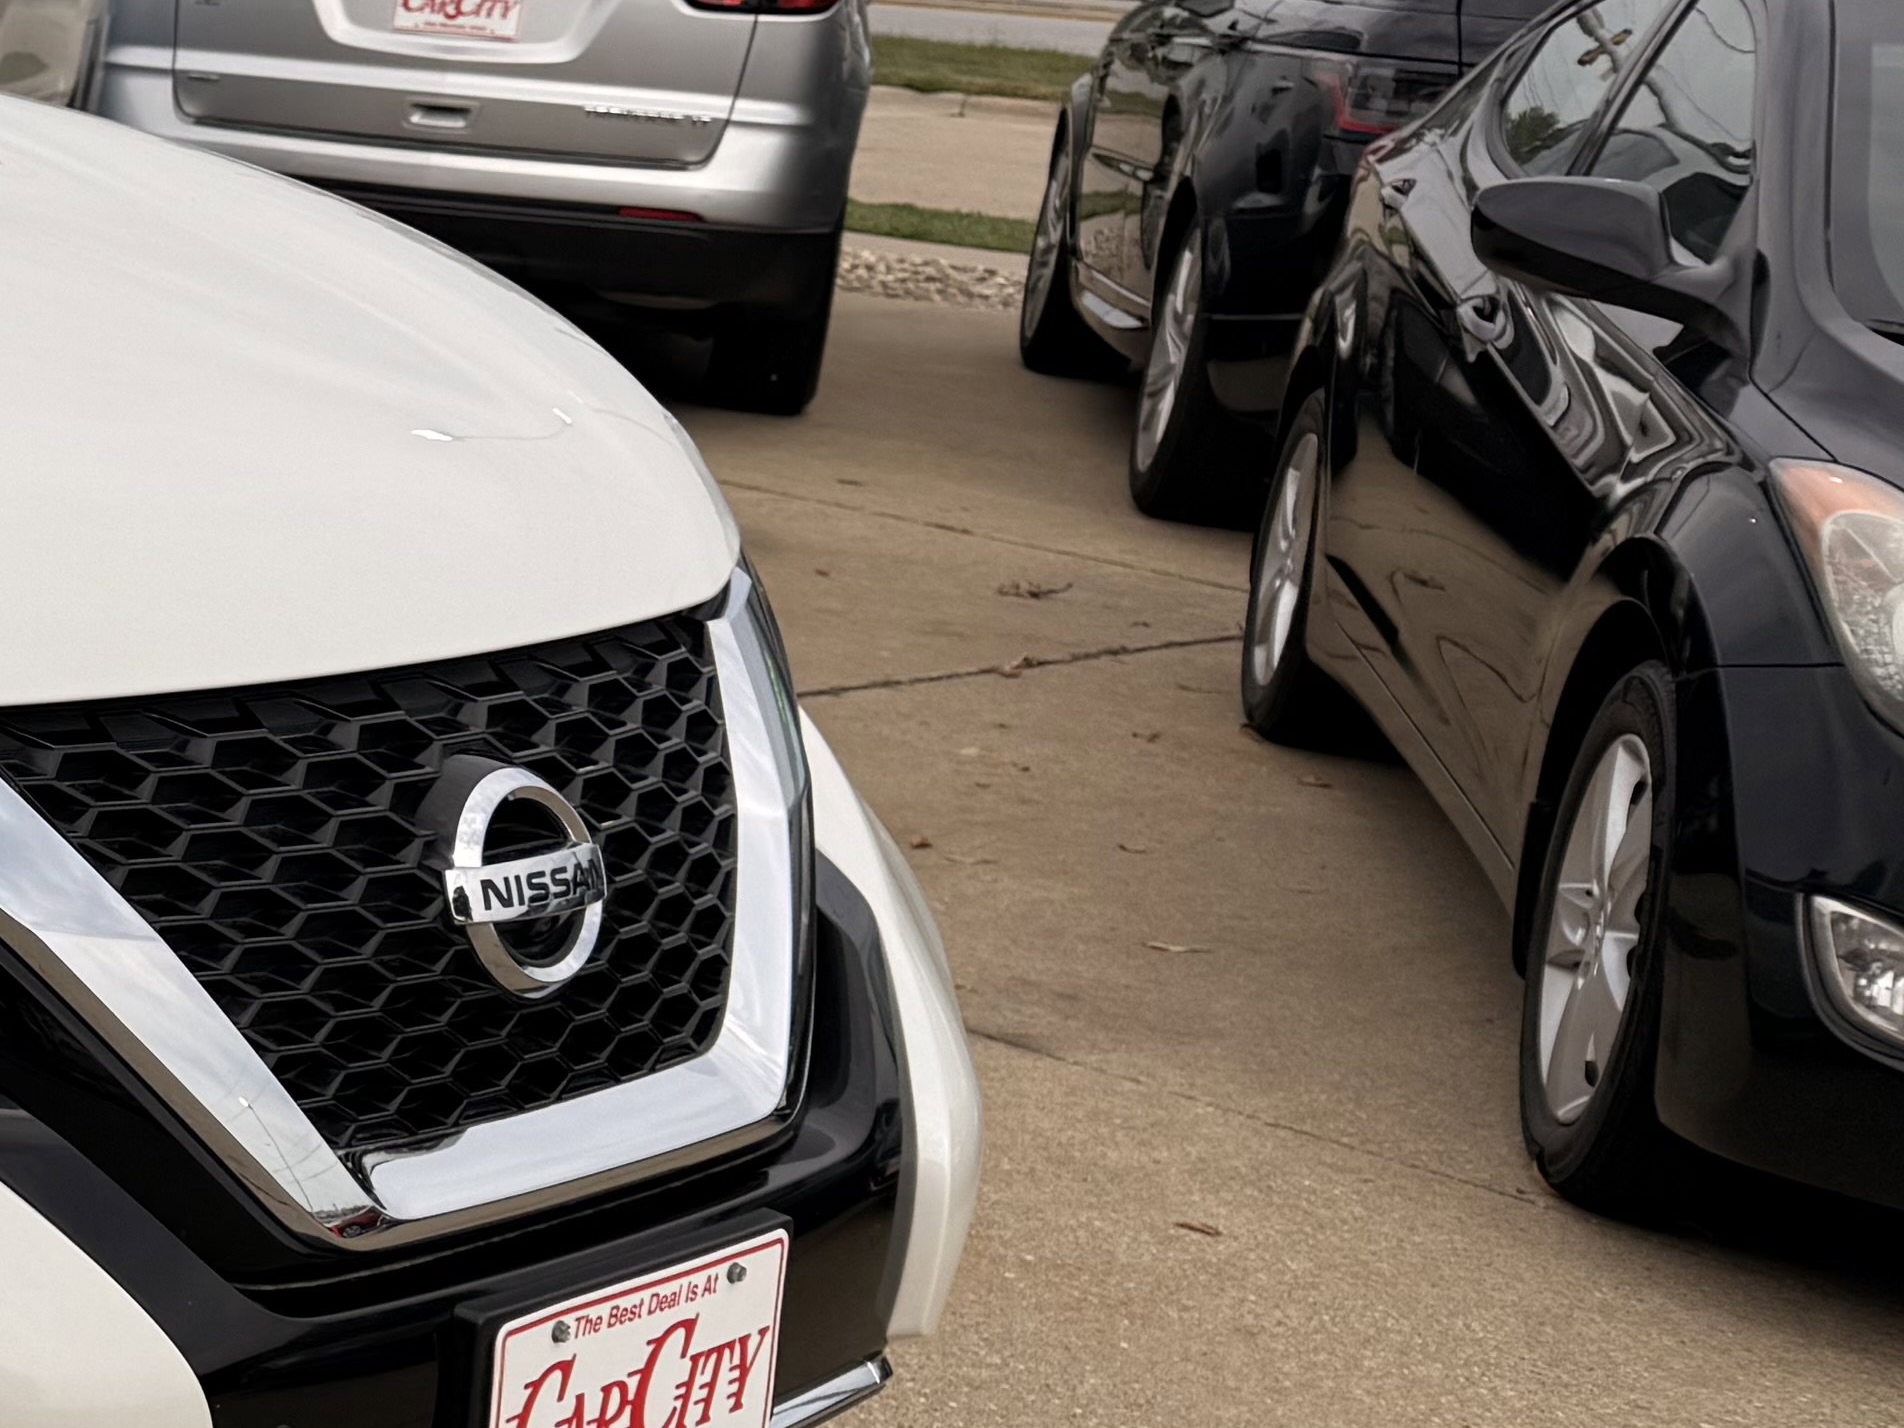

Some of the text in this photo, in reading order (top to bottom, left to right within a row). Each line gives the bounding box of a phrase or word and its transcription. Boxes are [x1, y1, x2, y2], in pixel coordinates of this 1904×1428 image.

[480, 858, 604, 911] NISSAN
[573, 1273, 719, 1340] The Best Deal Is At
